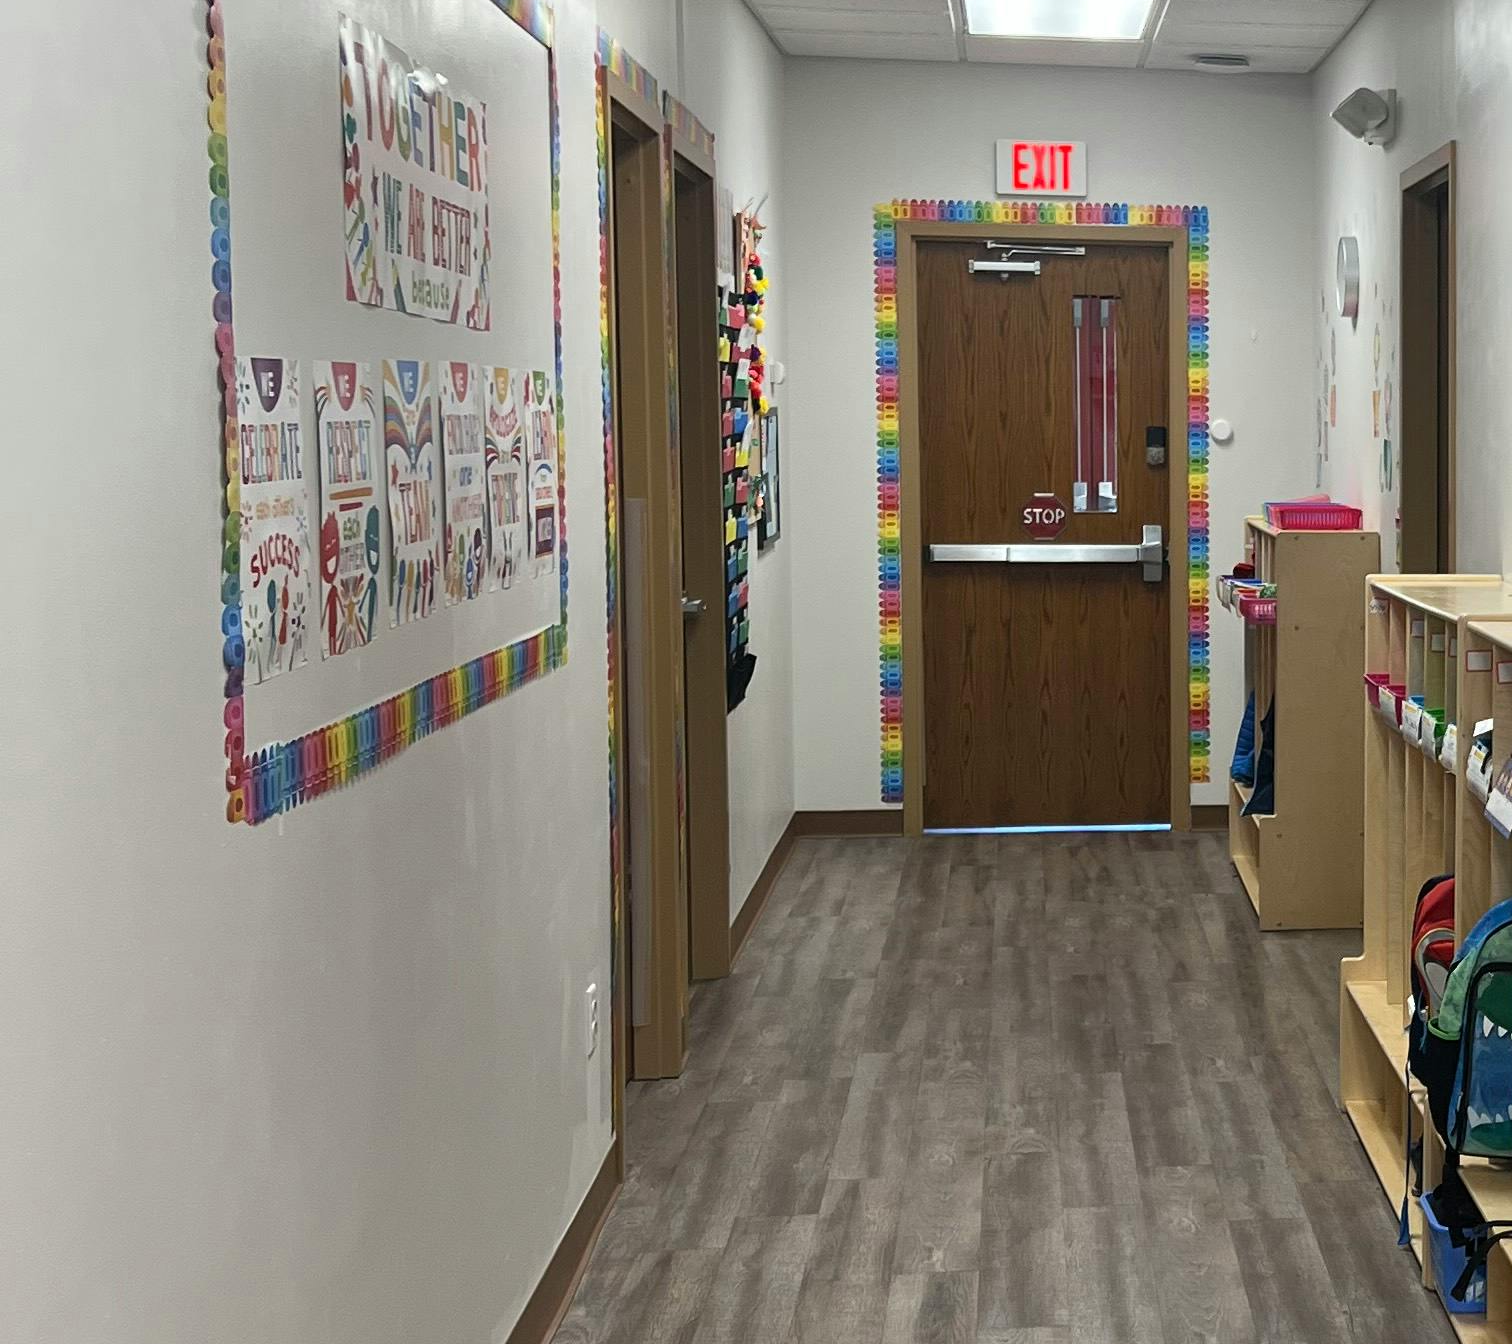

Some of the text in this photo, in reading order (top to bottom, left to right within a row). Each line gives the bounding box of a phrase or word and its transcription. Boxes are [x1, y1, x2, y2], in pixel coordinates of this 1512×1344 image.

[353, 41, 481, 192] TOGETHER
[1012, 143, 1073, 191] EXIT
[382, 172, 471, 277] WE ARE BETTER
[411, 270, 450, 311] because
[1023, 507, 1065, 526] STOP
[250, 532, 301, 588] SUCCESS
